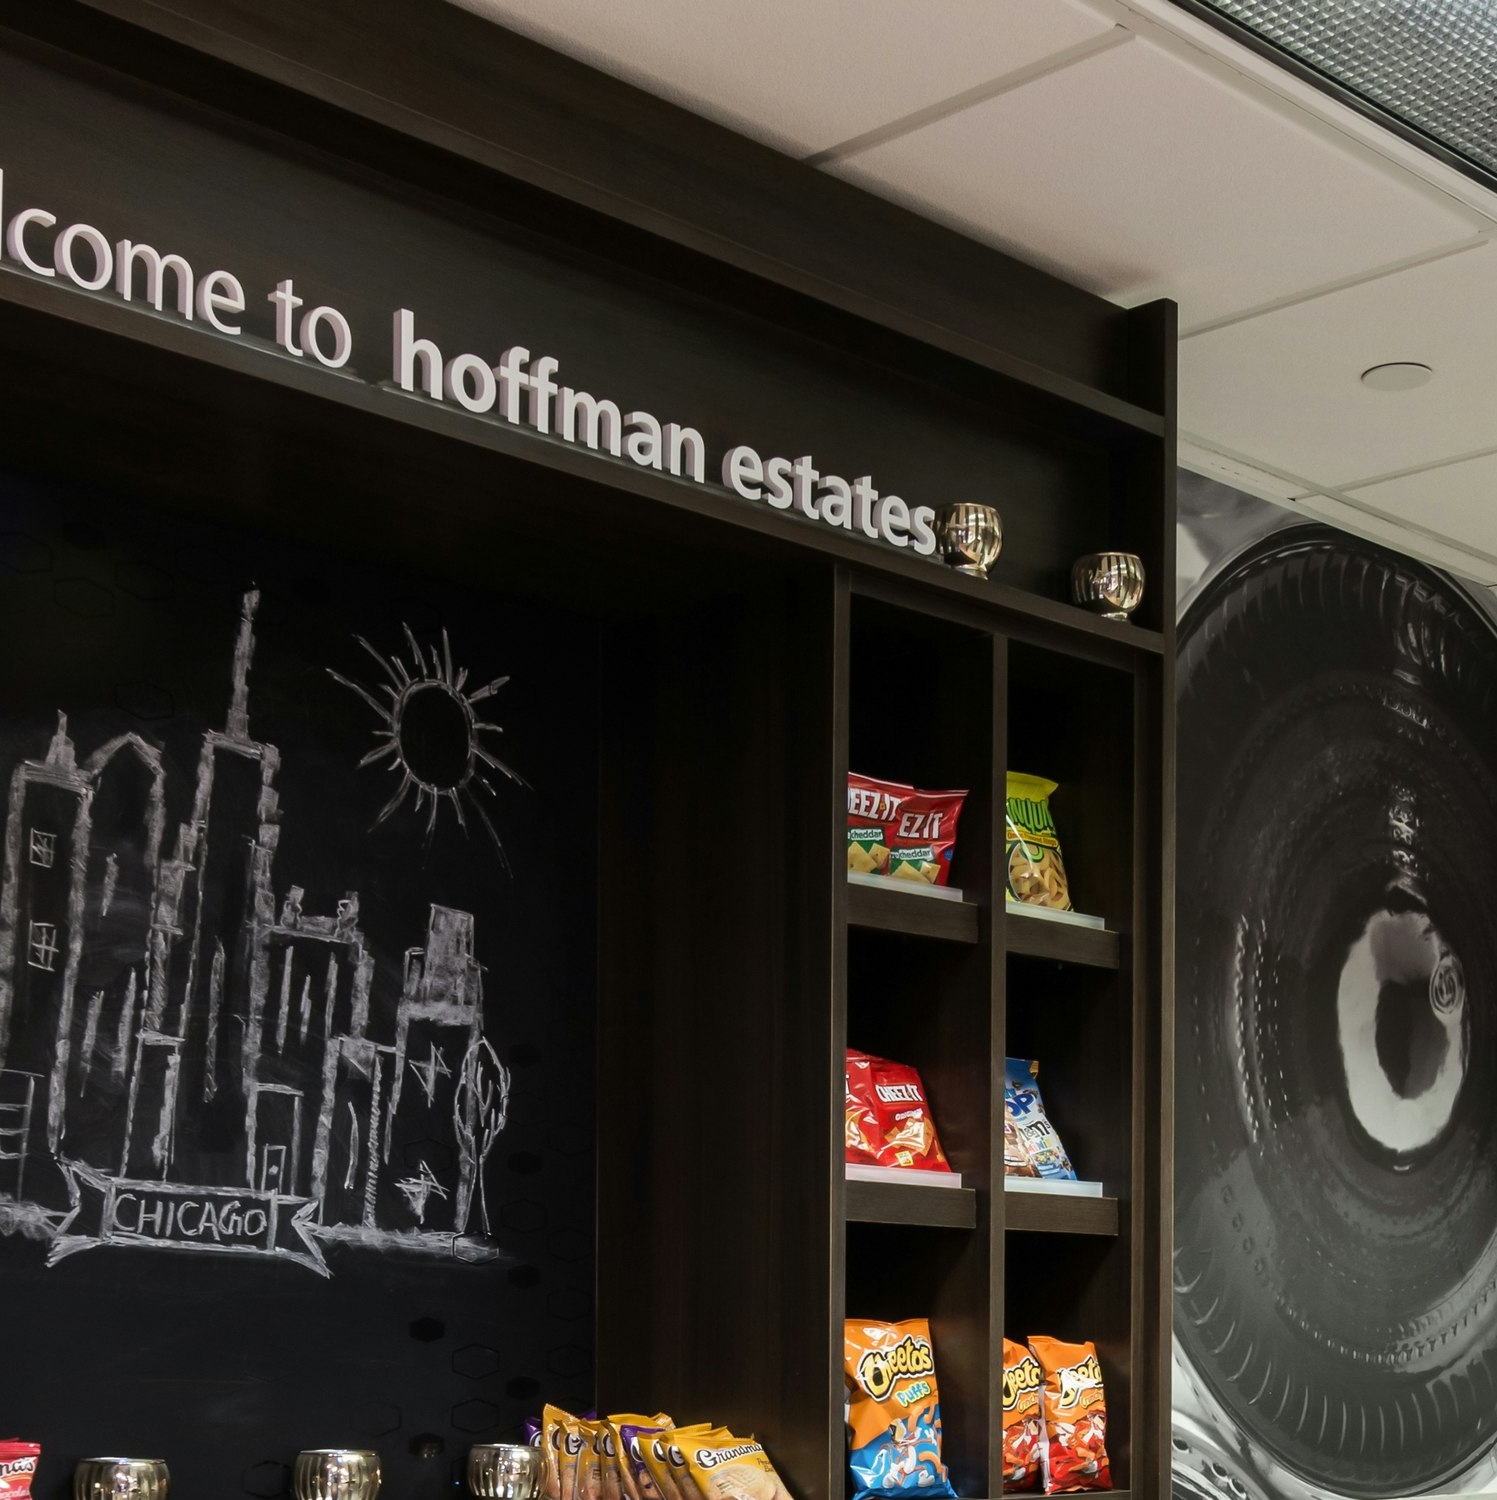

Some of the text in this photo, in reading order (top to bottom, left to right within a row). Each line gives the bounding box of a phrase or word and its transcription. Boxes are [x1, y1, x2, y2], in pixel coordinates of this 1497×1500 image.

[267, 279, 352, 368] to
[393, 308, 706, 483] hoffman
[722, 445, 936, 555] estates
[112, 1193, 267, 1240] CHICAGO
[860, 1337, 934, 1397] Cheetos
[895, 1381, 931, 1407] Puffs
